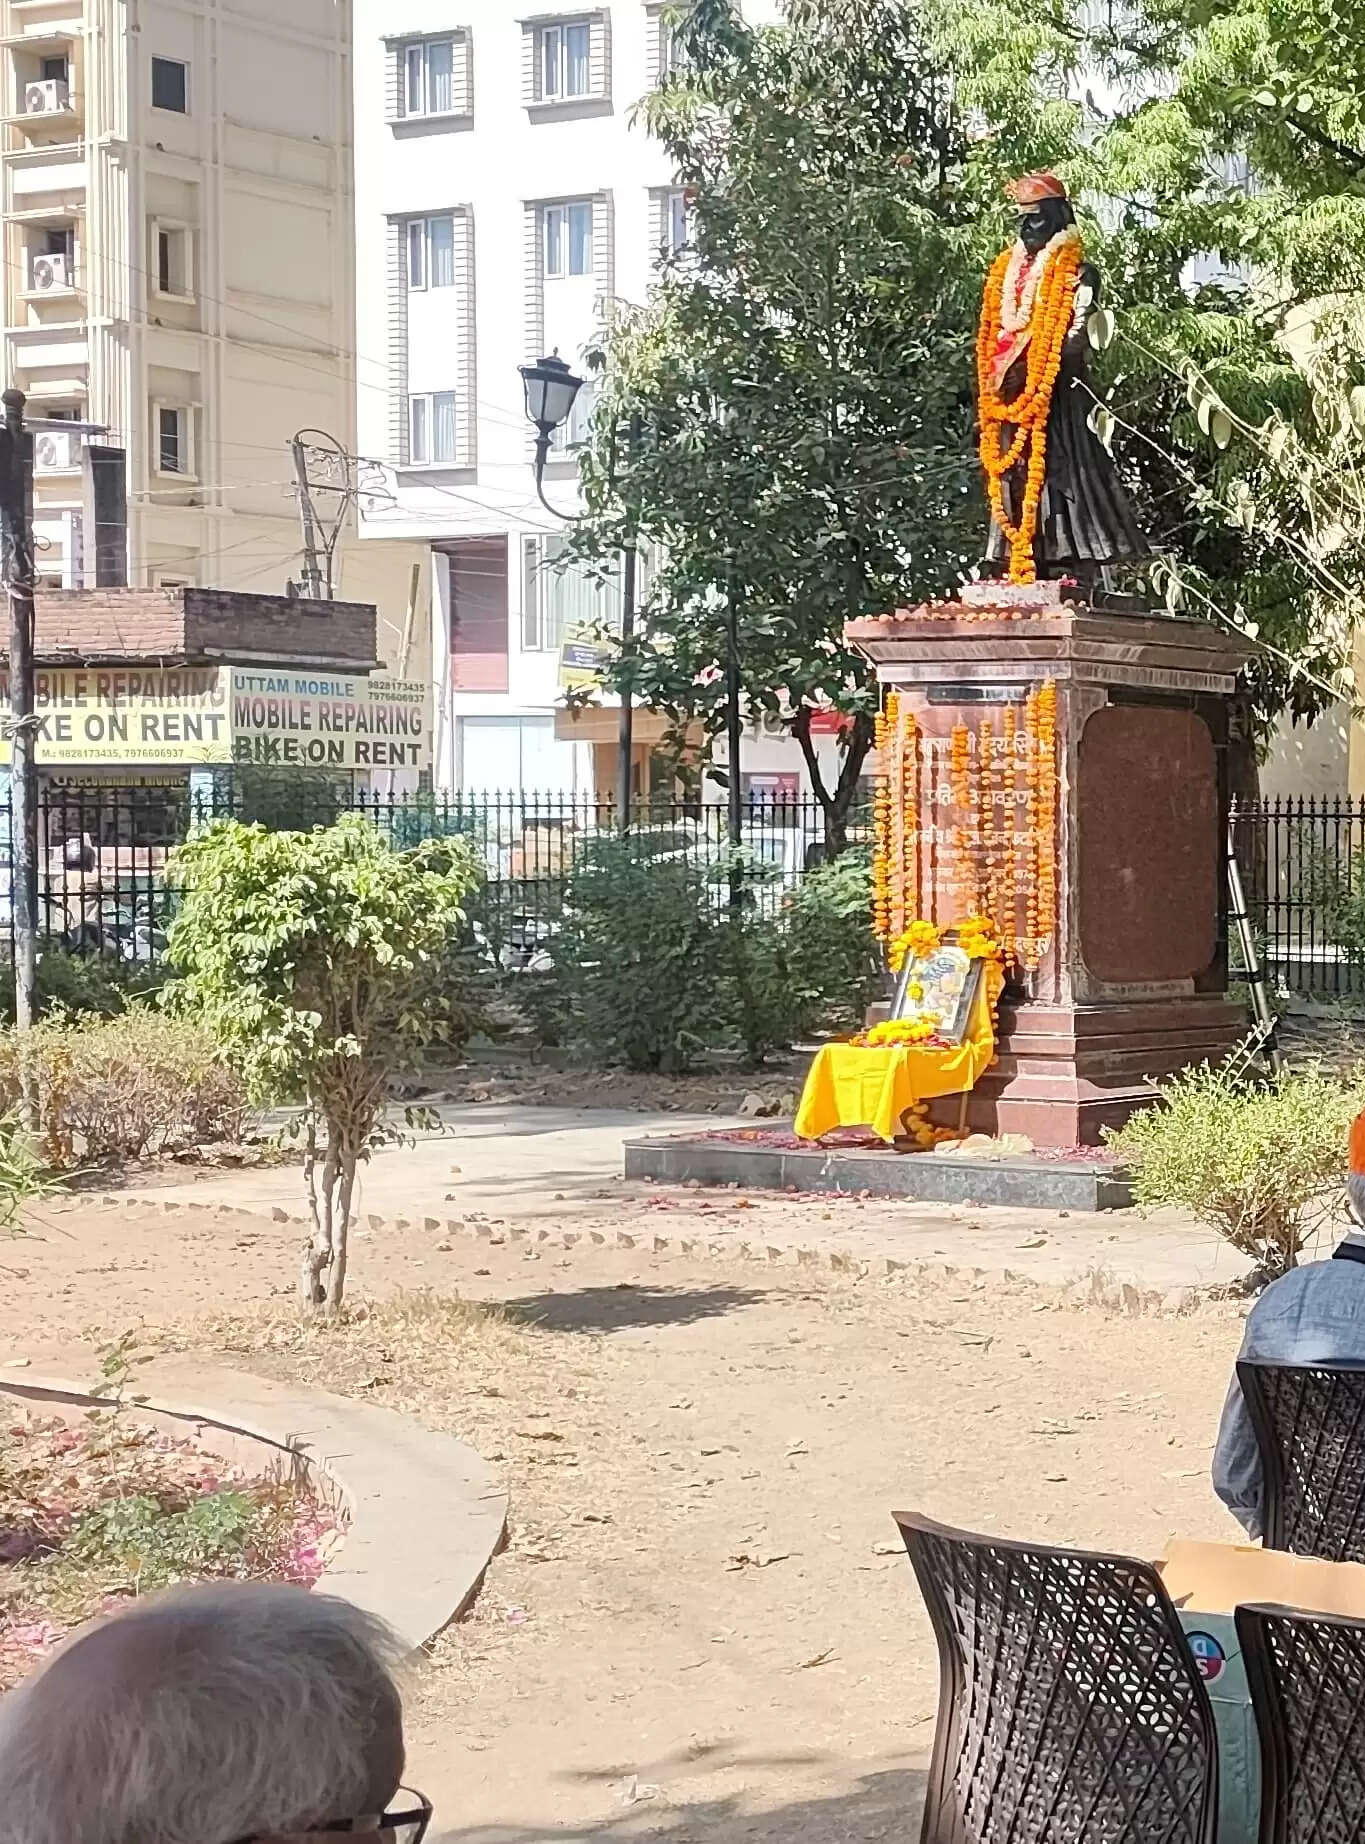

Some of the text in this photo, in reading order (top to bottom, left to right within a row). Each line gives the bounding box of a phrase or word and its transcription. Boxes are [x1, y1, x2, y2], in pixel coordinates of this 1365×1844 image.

[97, 671, 225, 709] REPAIRING
[234, 675, 355, 697] UTTAM MOBILE
[84, 714, 129, 742] ON
[141, 714, 225, 742] RENT
[234, 696, 422, 736] MOBILE REPAIRING
[235, 735, 422, 766] BIKE ON RENT
